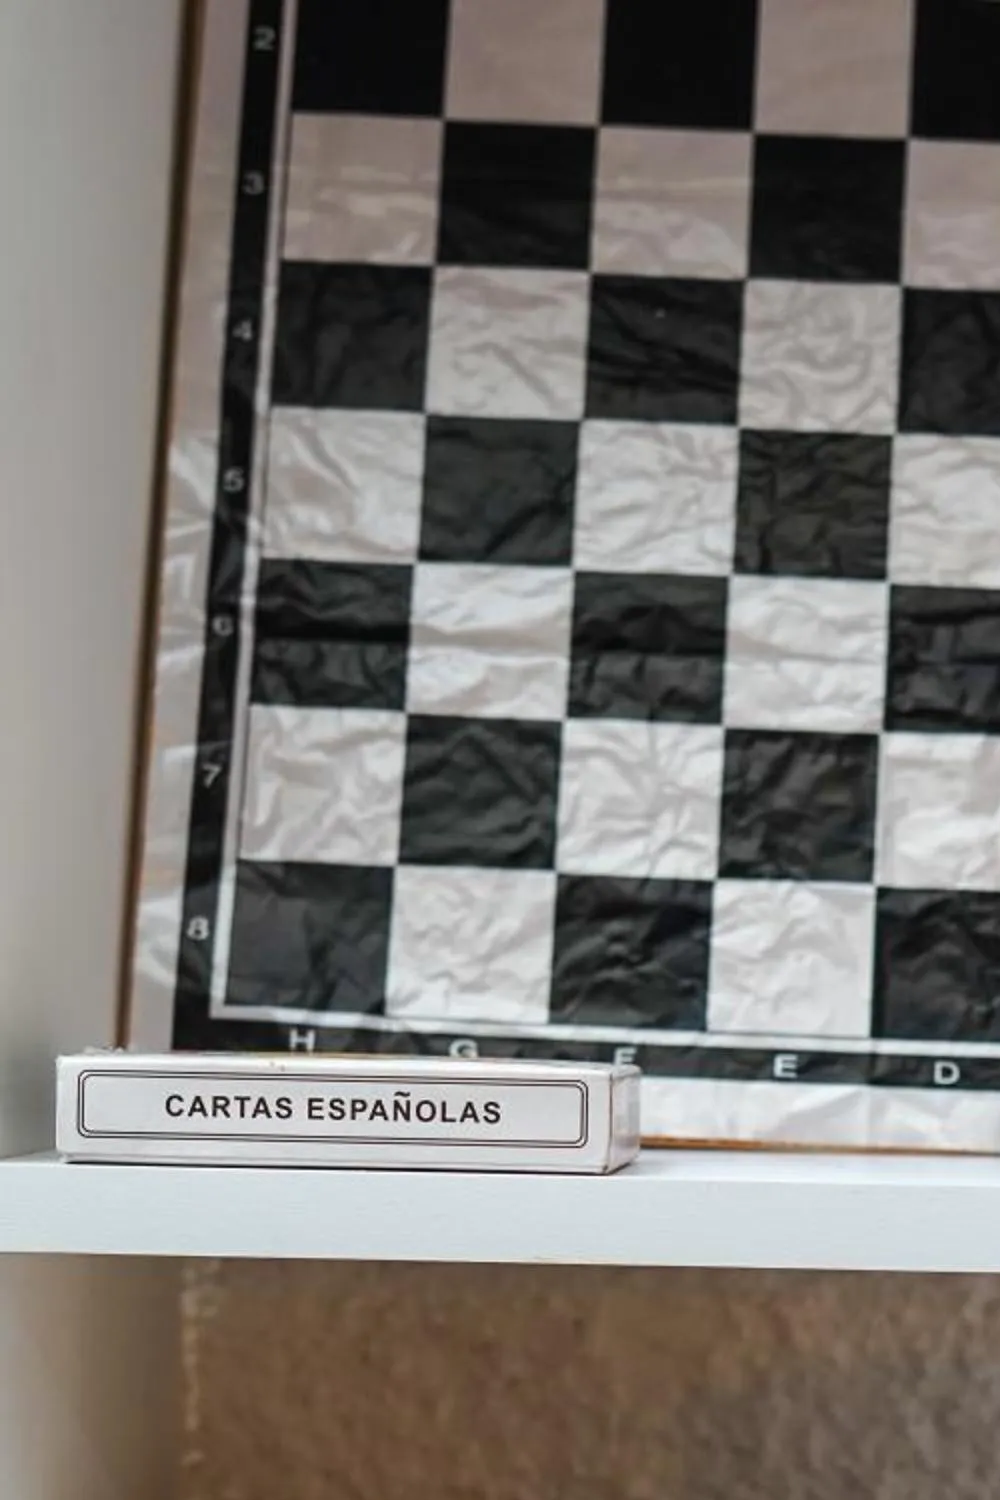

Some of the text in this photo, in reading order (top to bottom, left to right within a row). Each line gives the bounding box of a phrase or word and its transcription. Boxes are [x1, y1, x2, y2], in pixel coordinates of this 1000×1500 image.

[254, 26, 276, 51] 2
[242, 170, 264, 195] 3
[233, 320, 252, 341] 4
[224, 467, 244, 492] 5
[212, 614, 233, 636] 6
[202, 764, 222, 788] 7
[187, 915, 210, 940] 8
[289, 1029, 314, 1052] H
[774, 1055, 797, 1078] E
[935, 1061, 959, 1084] D
[165, 1090, 502, 1126] CARTAS ESPAÑOLAS
